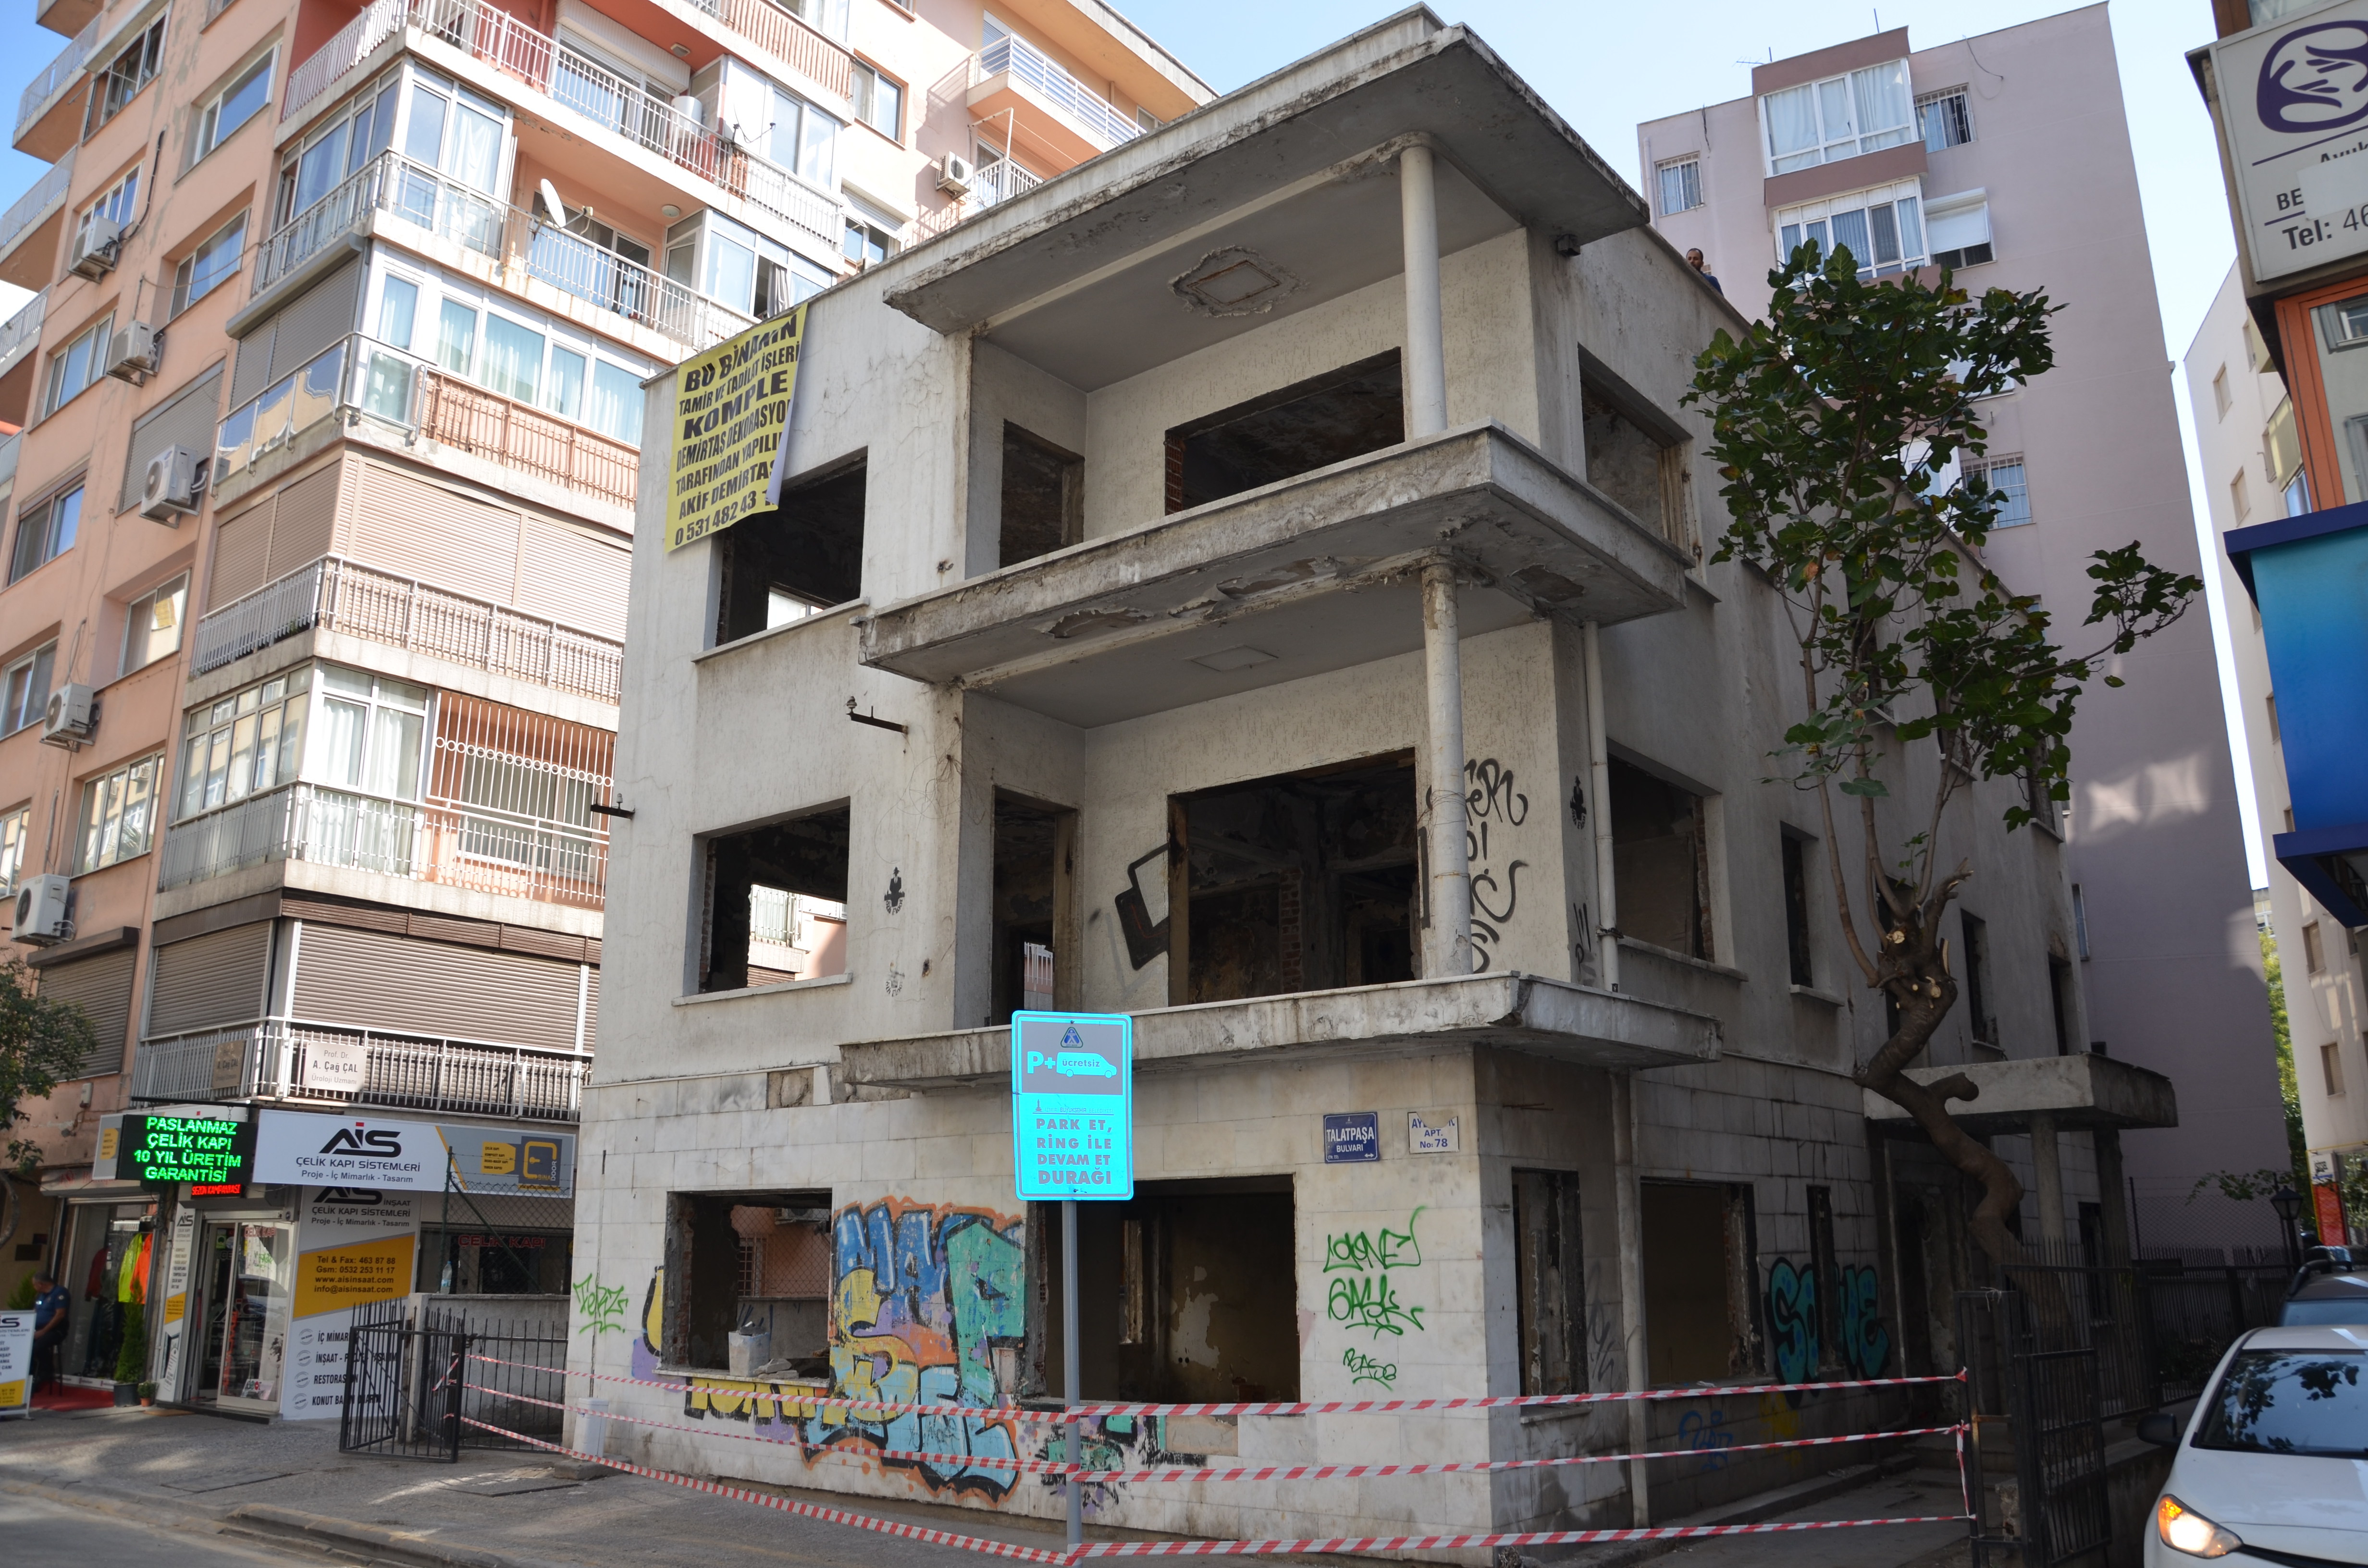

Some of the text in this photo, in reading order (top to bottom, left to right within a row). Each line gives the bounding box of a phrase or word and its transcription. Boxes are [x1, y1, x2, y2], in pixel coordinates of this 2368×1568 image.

[2282, 220, 2332, 250] Tel:
[679, 341, 800, 416] TAMİR VE TADİLAT İŞLERİ
[684, 363, 715, 392] BU
[683, 369, 788, 440] KOMPLE
[677, 431, 726, 472] DEMİRTAŞ
[677, 451, 740, 496] TARAFINDAN
[679, 491, 709, 520] AKİF
[675, 527, 683, 546] 0
[687, 515, 710, 540] 531
[712, 502, 738, 527] 482
[740, 490, 756, 513] 43
[324, 1050, 338, 1058] Prof.
[313, 1061, 358, 1073] A. Çağ ÇAL
[1062, 1059, 1100, 1067] ücretsiz
[312, 1074, 333, 1083] Üroloji
[147, 1116, 237, 1135] PASLANMAZ
[1036, 1118, 1112, 1133] PARK ET,
[148, 1132, 232, 1150] ÇELİK KAPI
[319, 1122, 401, 1158] AİS
[1037, 1134, 1111, 1149] RİNG İLE
[1326, 1127, 1374, 1144] TALATPAŞA
[1435, 1138, 1448, 1148] 78
[1336, 1144, 1363, 1152] BULVARI
[135, 1149, 241, 1167] 10 YIL ÜRETİM
[296, 1156, 420, 1172] ÇELİK KAPI SİSTEMLERİ
[1037, 1154, 1110, 1165] DEVAM ET
[146, 1166, 226, 1182] GARANTİSİ
[302, 1170, 323, 1179] Proje
[331, 1171, 338, 1180] İç
[341, 1172, 375, 1181] Mimarlık
[382, 1174, 413, 1183] Tasarım
[1038, 1167, 1111, 1185] DURAĞI
[383, 1199, 411, 1207] İNŞAAT
[312, 1206, 335, 1215] ÇELİK
[361, 1207, 410, 1217] SİSTEMLERİ
[311, 1217, 330, 1225] Proje
[337, 1217, 344, 1225] İç
[458, 1235, 545, 1249] ÇELİK KAPI
[314, 1286, 393, 1294] info@aisinsaat.com
[318, 1330, 324, 1345] İÇ
[326, 1330, 350, 1342] MİMAR
[316, 1352, 338, 1366] İNŞAAT
[312, 1395, 333, 1406] KONUT
